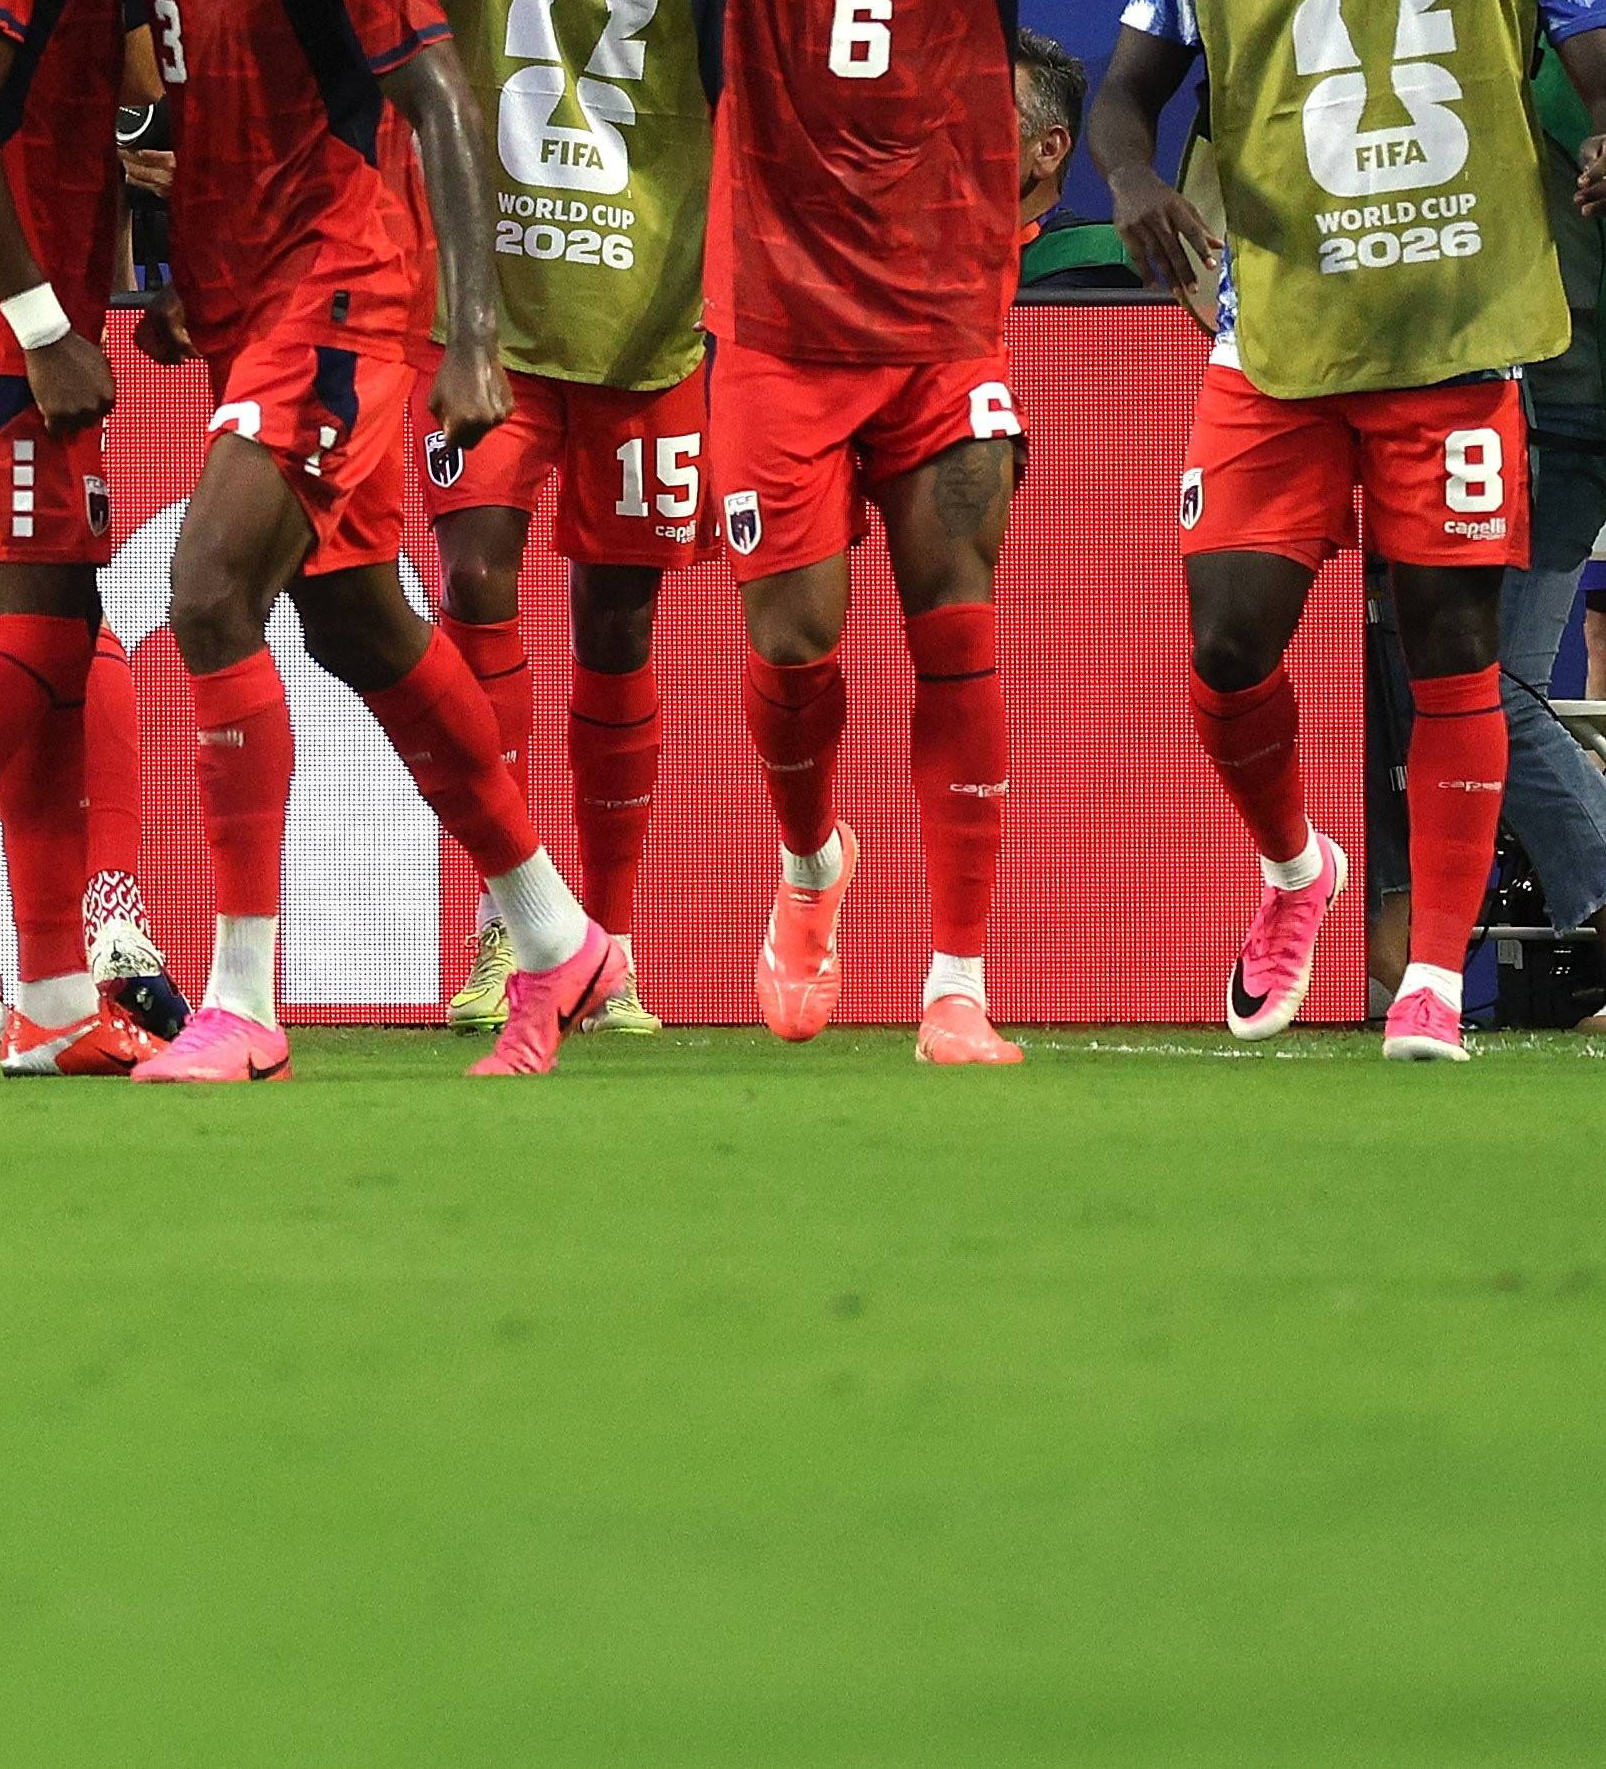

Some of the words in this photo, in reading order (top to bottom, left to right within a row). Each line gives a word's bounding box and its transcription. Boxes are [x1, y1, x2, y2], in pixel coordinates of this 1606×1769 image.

[541, 138, 604, 169] FIFA
[1356, 138, 1428, 172] FIFA
[497, 193, 587, 223] WORLD
[591, 204, 636, 229] CUP
[1316, 198, 1415, 233] WORLD
[1421, 193, 1477, 221] CUP
[495, 221, 635, 270] 2026
[1319, 220, 1481, 274] 2026
[615, 432, 701, 518] 15
[1444, 428, 1504, 513] 8
[1443, 517, 1506, 539] capelli
